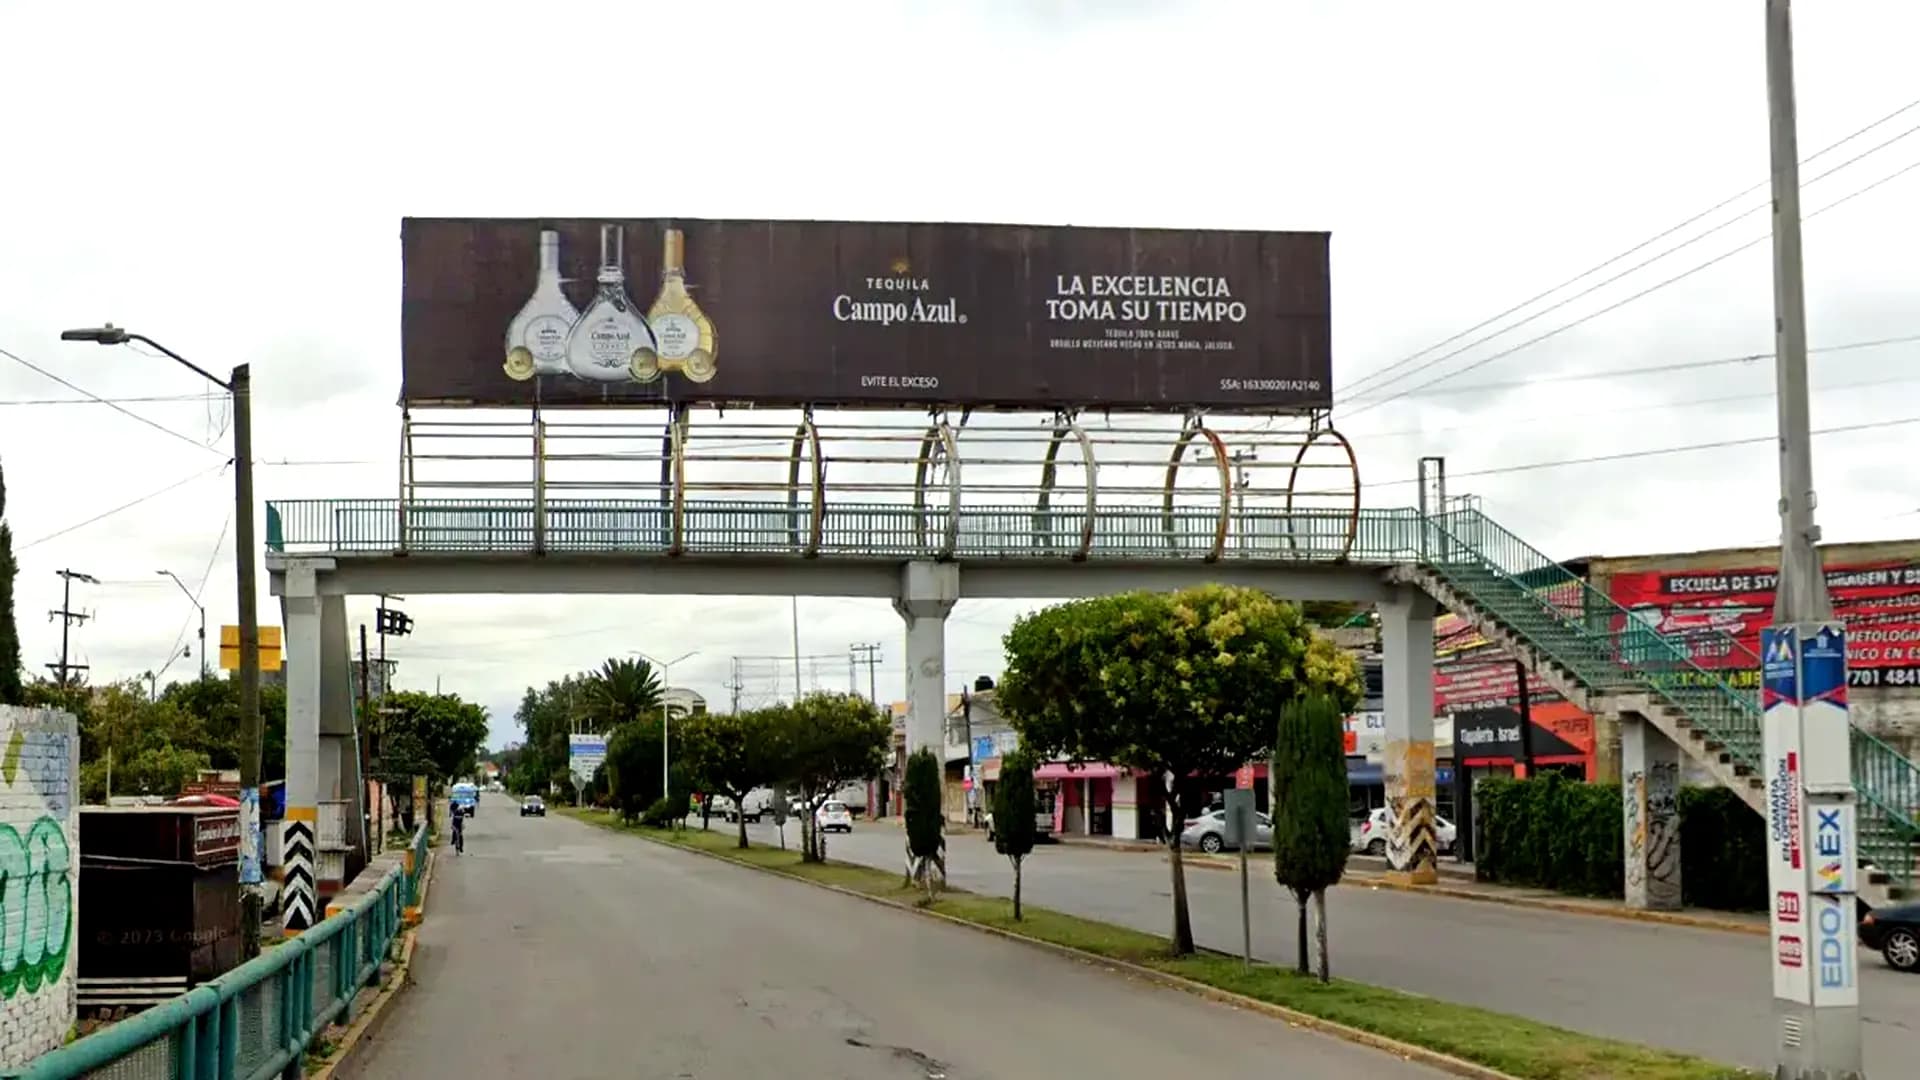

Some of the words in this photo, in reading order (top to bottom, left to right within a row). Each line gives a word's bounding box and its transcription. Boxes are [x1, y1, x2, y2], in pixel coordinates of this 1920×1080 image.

[866, 278, 929, 291] TEQUILA
[1057, 275, 1085, 295] LA
[1092, 275, 1231, 298] EXCELENCIA
[833, 294, 907, 326] Campo
[911, 298, 957, 324] Azul
[1046, 299, 1116, 320] TOMA
[1121, 300, 1150, 321] SU
[1156, 301, 1247, 323] TIEMPO
[1105, 328, 1133, 339] TEQUILA
[1050, 339, 1080, 349] ORGULLO
[1083, 339, 1118, 350] MEXICANO
[1120, 340, 1142, 350] HECHO
[861, 376, 886, 387] EVITE
[888, 376, 899, 388] EL
[902, 377, 939, 389] EXCESO
[1220, 378, 1241, 390] SSA:
[1670, 577, 1728, 592] ESCUELA
[1732, 576, 1751, 590] DE
[1891, 570, 1901, 586] Y
